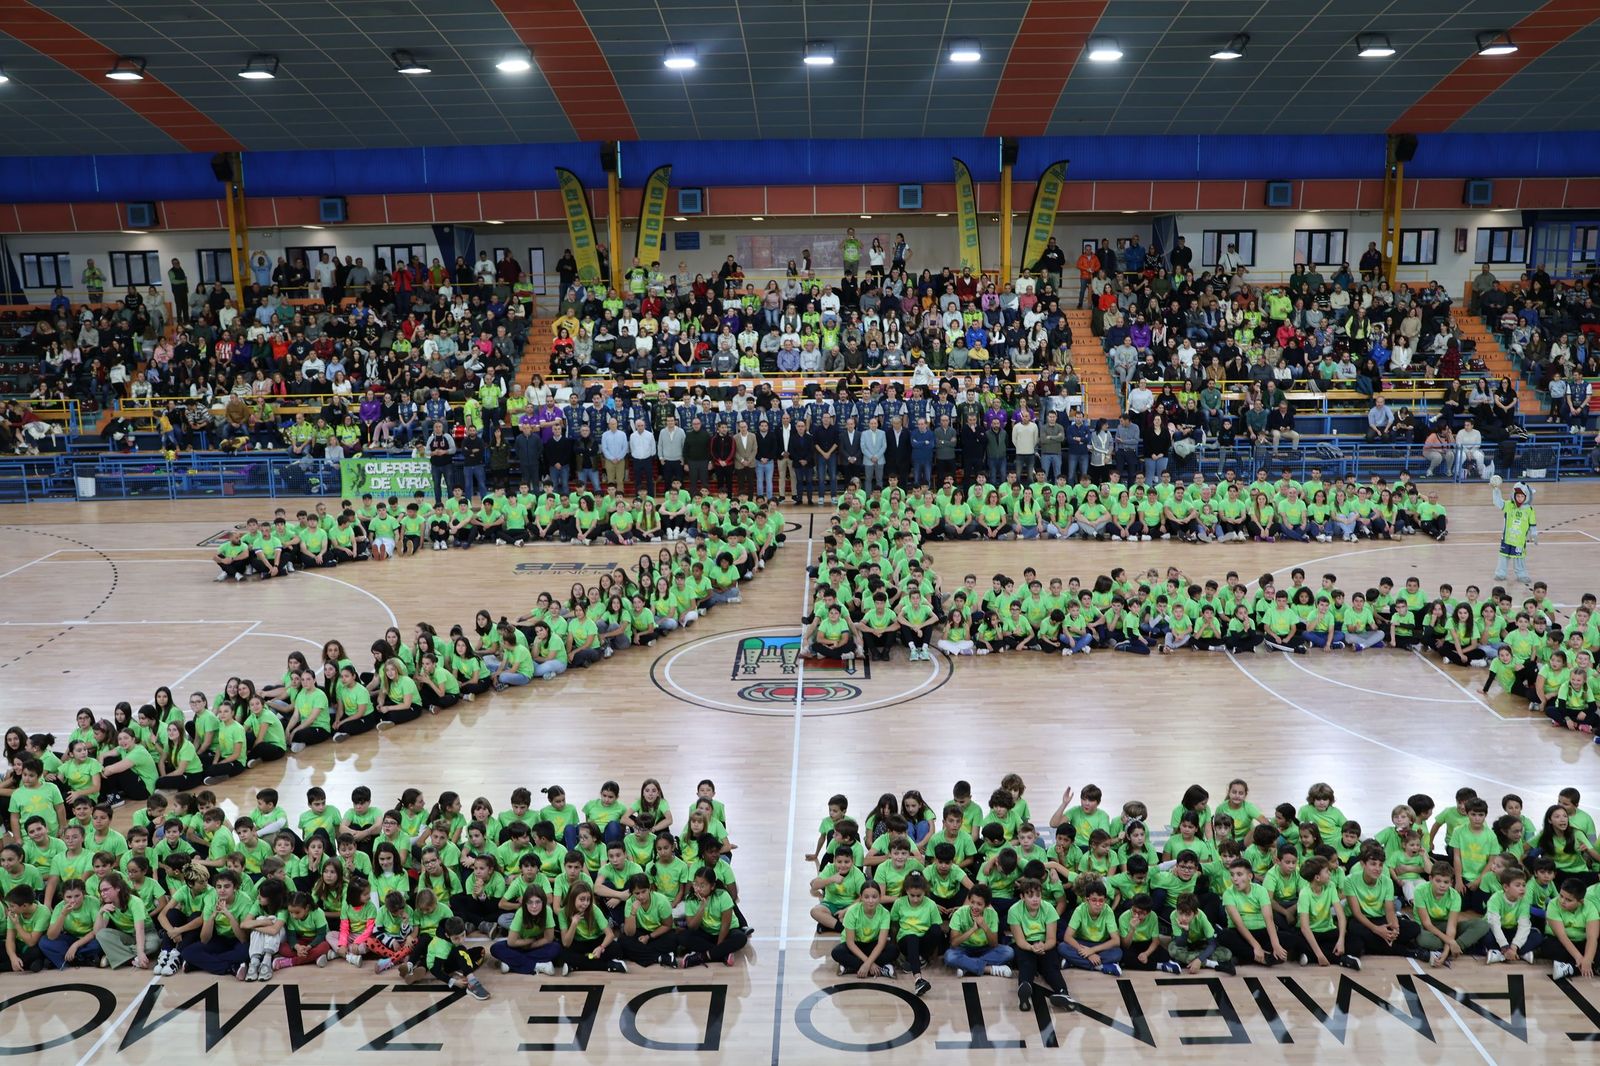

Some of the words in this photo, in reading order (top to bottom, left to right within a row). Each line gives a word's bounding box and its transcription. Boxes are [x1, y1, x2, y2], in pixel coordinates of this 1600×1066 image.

[365, 462, 432, 474] GUERRER
[371, 477, 391, 490] DE
[515, 562, 618, 570] FEB
[517, 984, 728, 1053] DE
